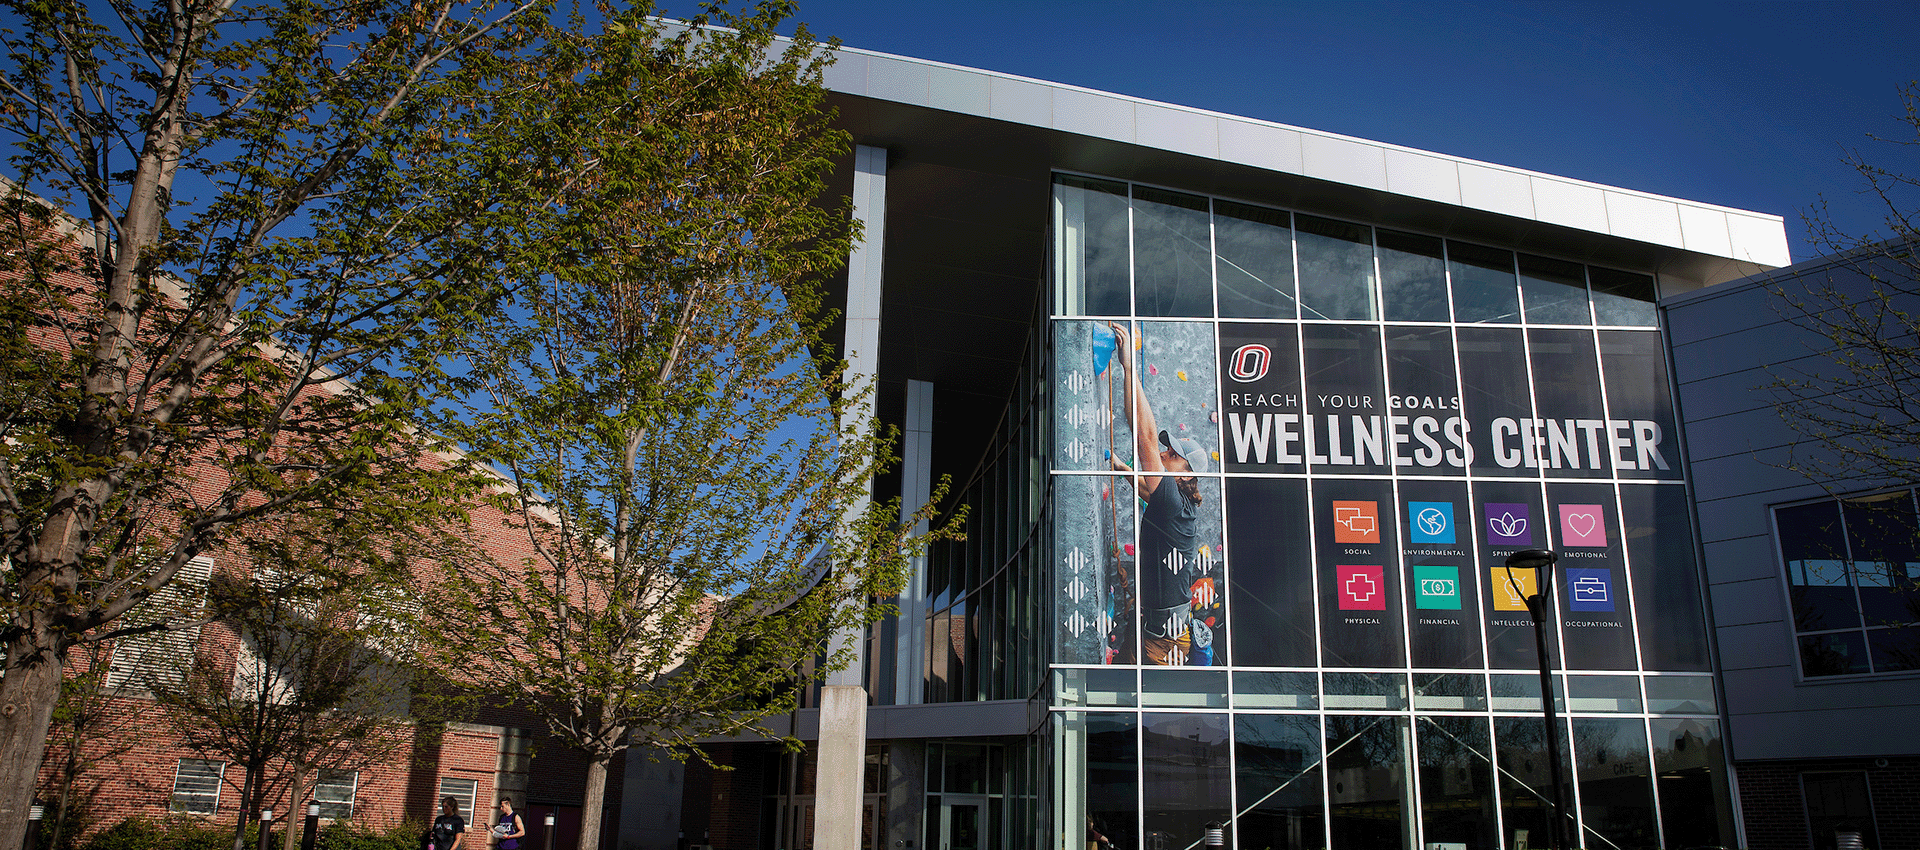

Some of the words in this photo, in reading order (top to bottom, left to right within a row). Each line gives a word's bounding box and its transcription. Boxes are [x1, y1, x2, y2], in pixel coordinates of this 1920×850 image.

[1230, 393, 1297, 406] REACH
[1318, 395, 1373, 409] YOUR
[1389, 395, 1460, 409] GOALS
[1228, 412, 1475, 467] WELLNESS
[1491, 417, 1671, 470] CENTER
[1491, 619, 1535, 627] INTELLECTU
[1565, 620, 1623, 628] OCCUPATIONAL
